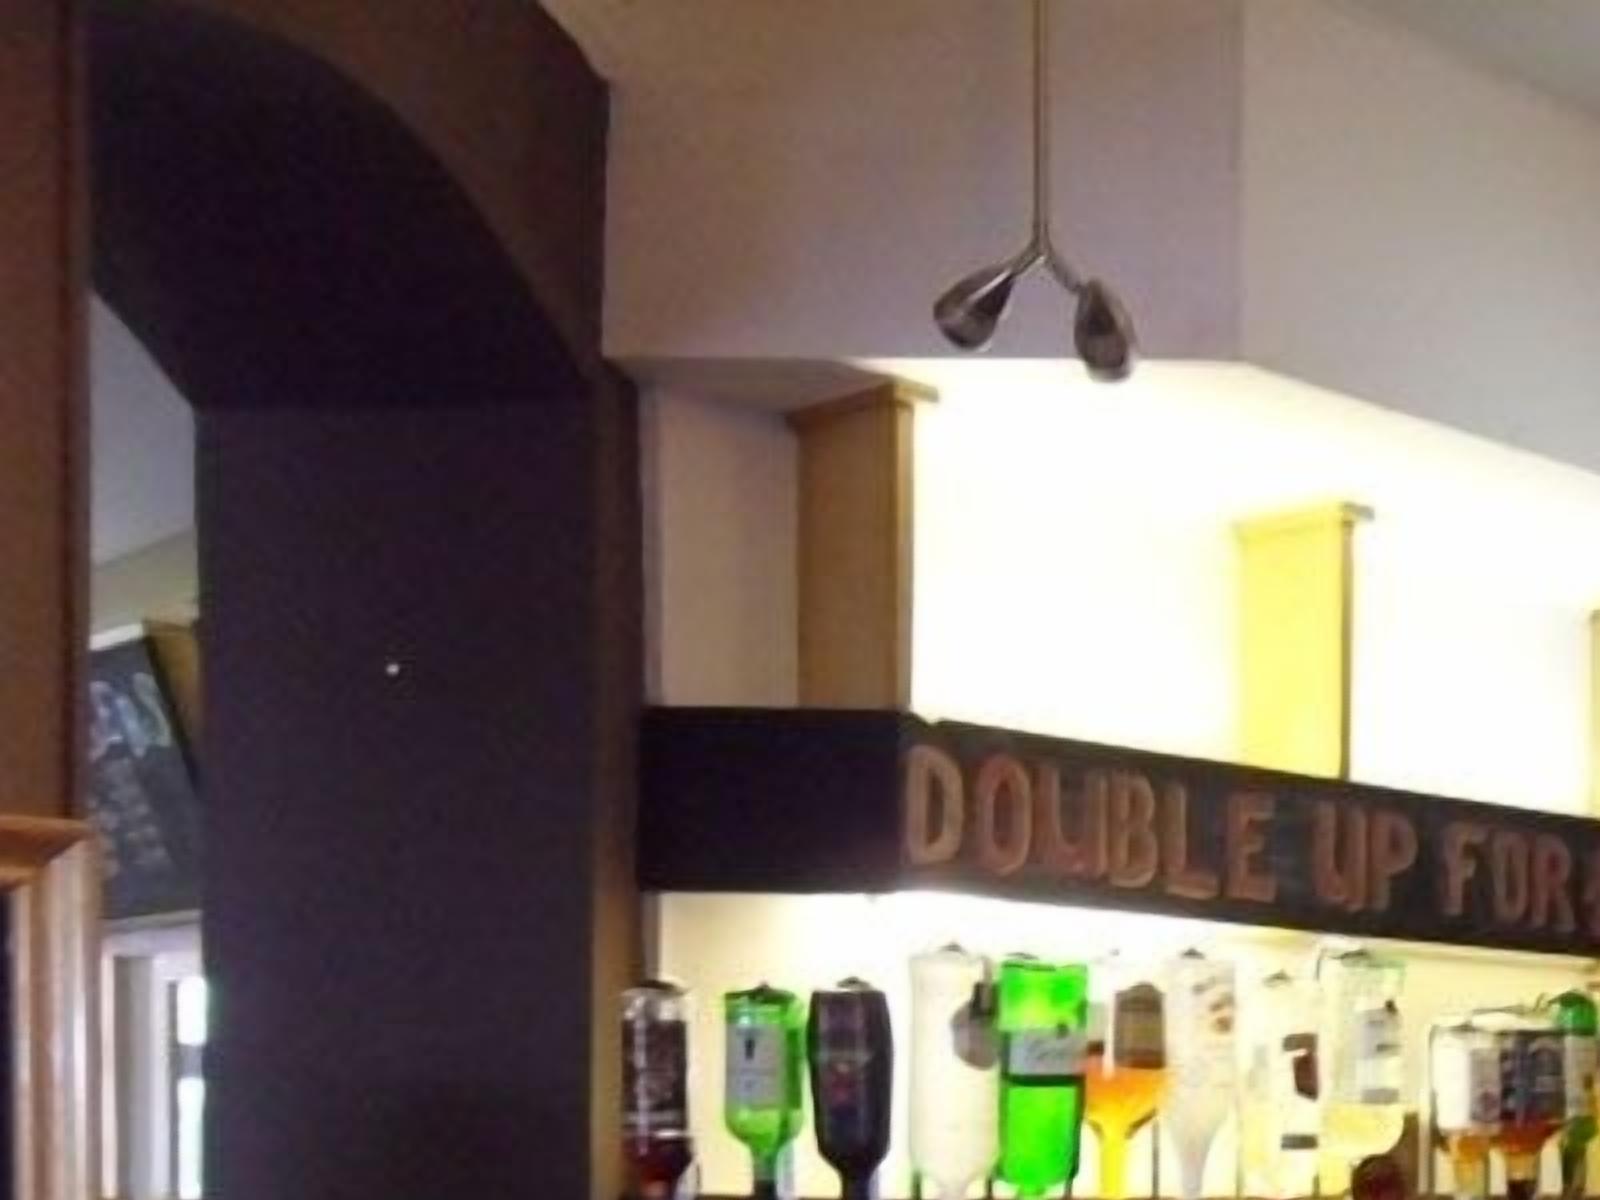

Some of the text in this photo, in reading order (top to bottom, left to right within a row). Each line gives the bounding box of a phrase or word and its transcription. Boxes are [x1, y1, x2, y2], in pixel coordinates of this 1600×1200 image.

[904, 742, 1278, 903] DOUBLE
[1312, 802, 1419, 912] UP
[1442, 821, 1577, 933] FOR
